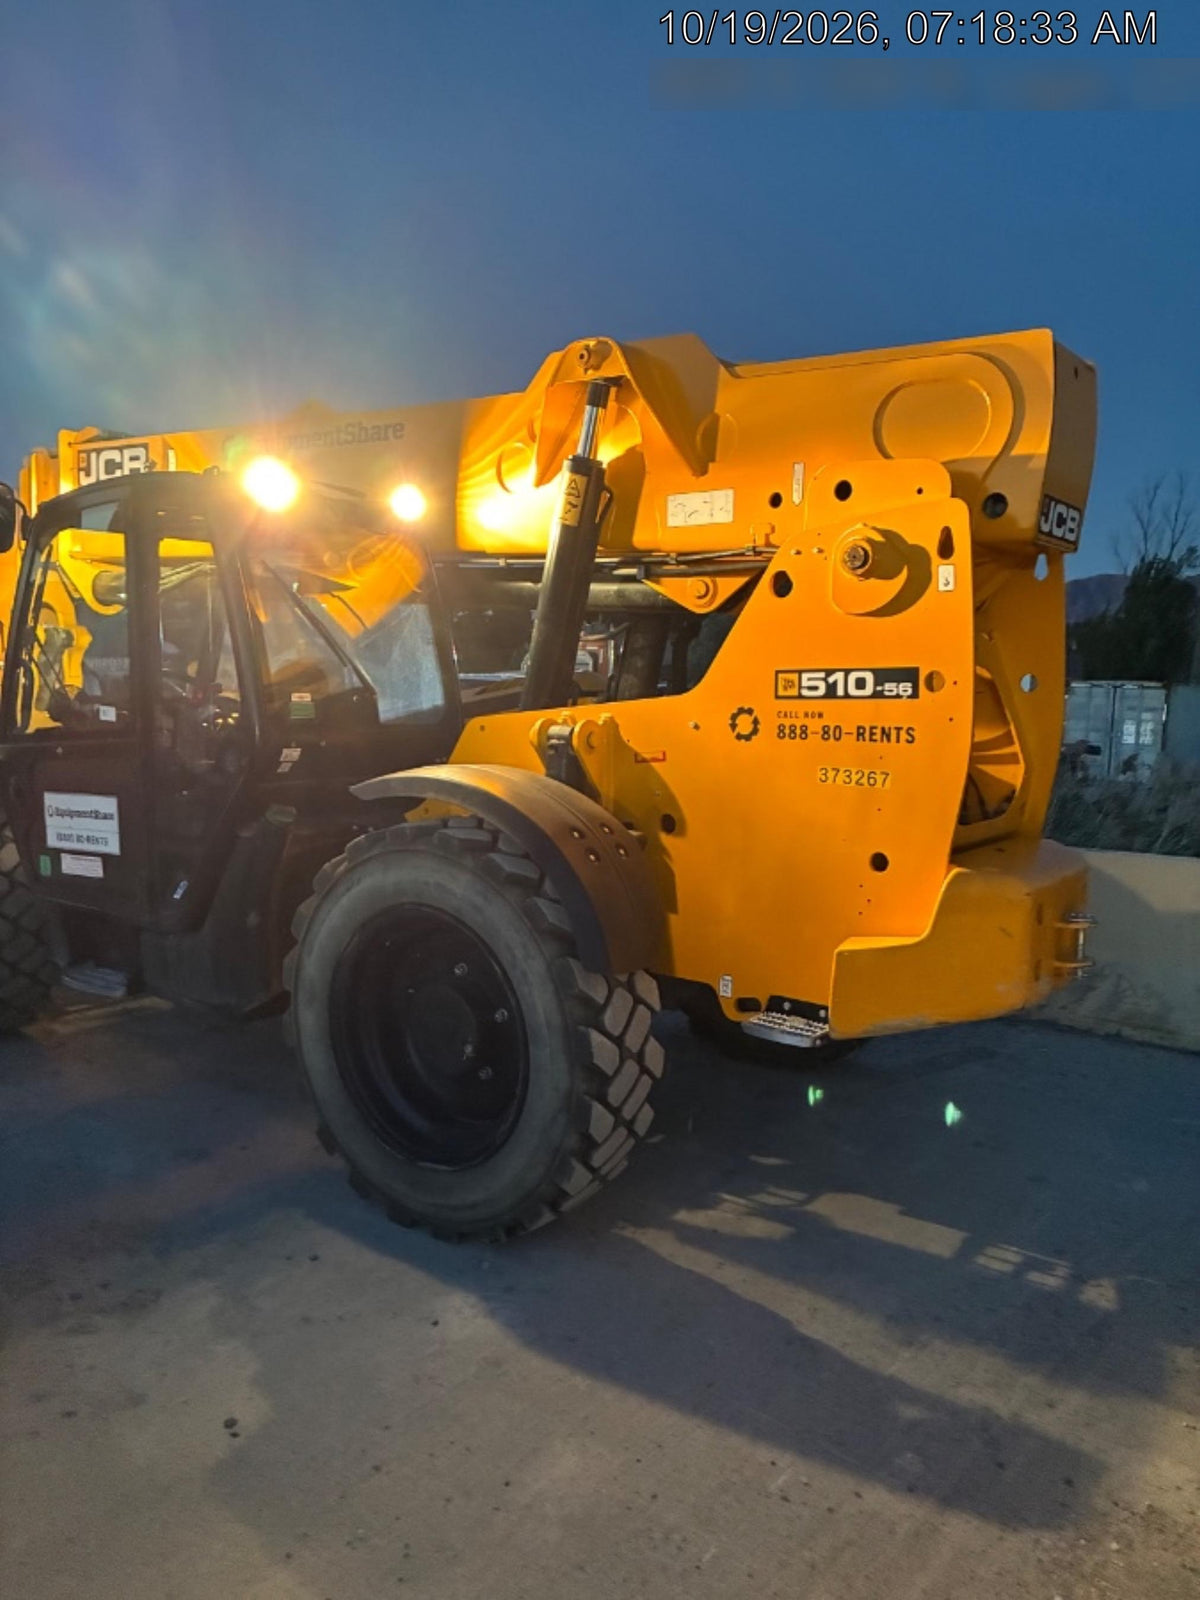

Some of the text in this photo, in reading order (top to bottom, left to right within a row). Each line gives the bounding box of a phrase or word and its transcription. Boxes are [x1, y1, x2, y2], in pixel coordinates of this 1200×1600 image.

[79, 447, 147, 485] JCB
[1040, 500, 1081, 541] JCB
[776, 711, 824, 719] CALL NOW
[776, 723, 916, 744] 888-80-RENTS
[818, 767, 890, 788] 373267
